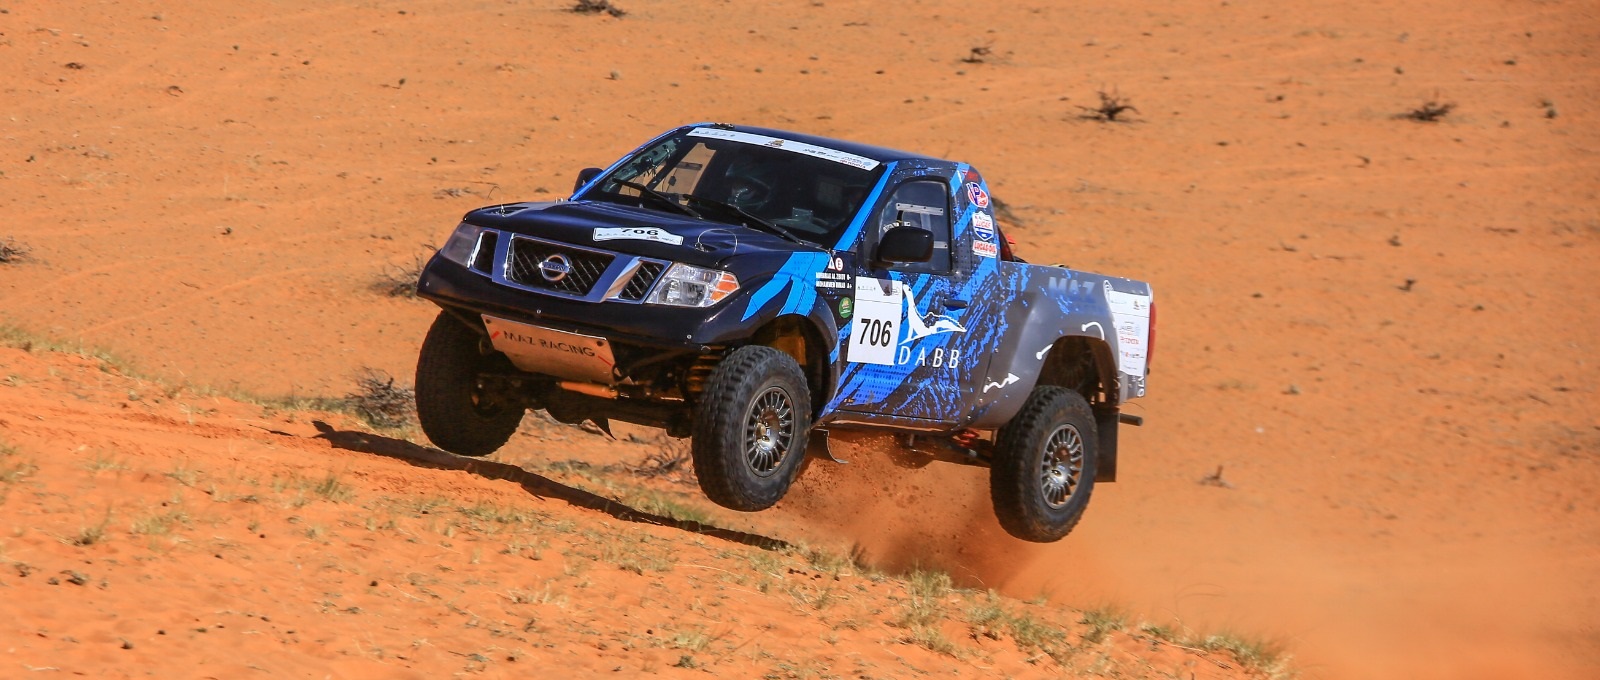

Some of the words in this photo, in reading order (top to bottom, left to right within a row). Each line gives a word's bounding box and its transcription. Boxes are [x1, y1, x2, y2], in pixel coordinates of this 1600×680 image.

[621, 228, 659, 236] 706
[503, 331, 536, 346] MAZ
[539, 339, 596, 357] RACING
[860, 318, 892, 347] 706
[898, 345, 960, 369] DABB
